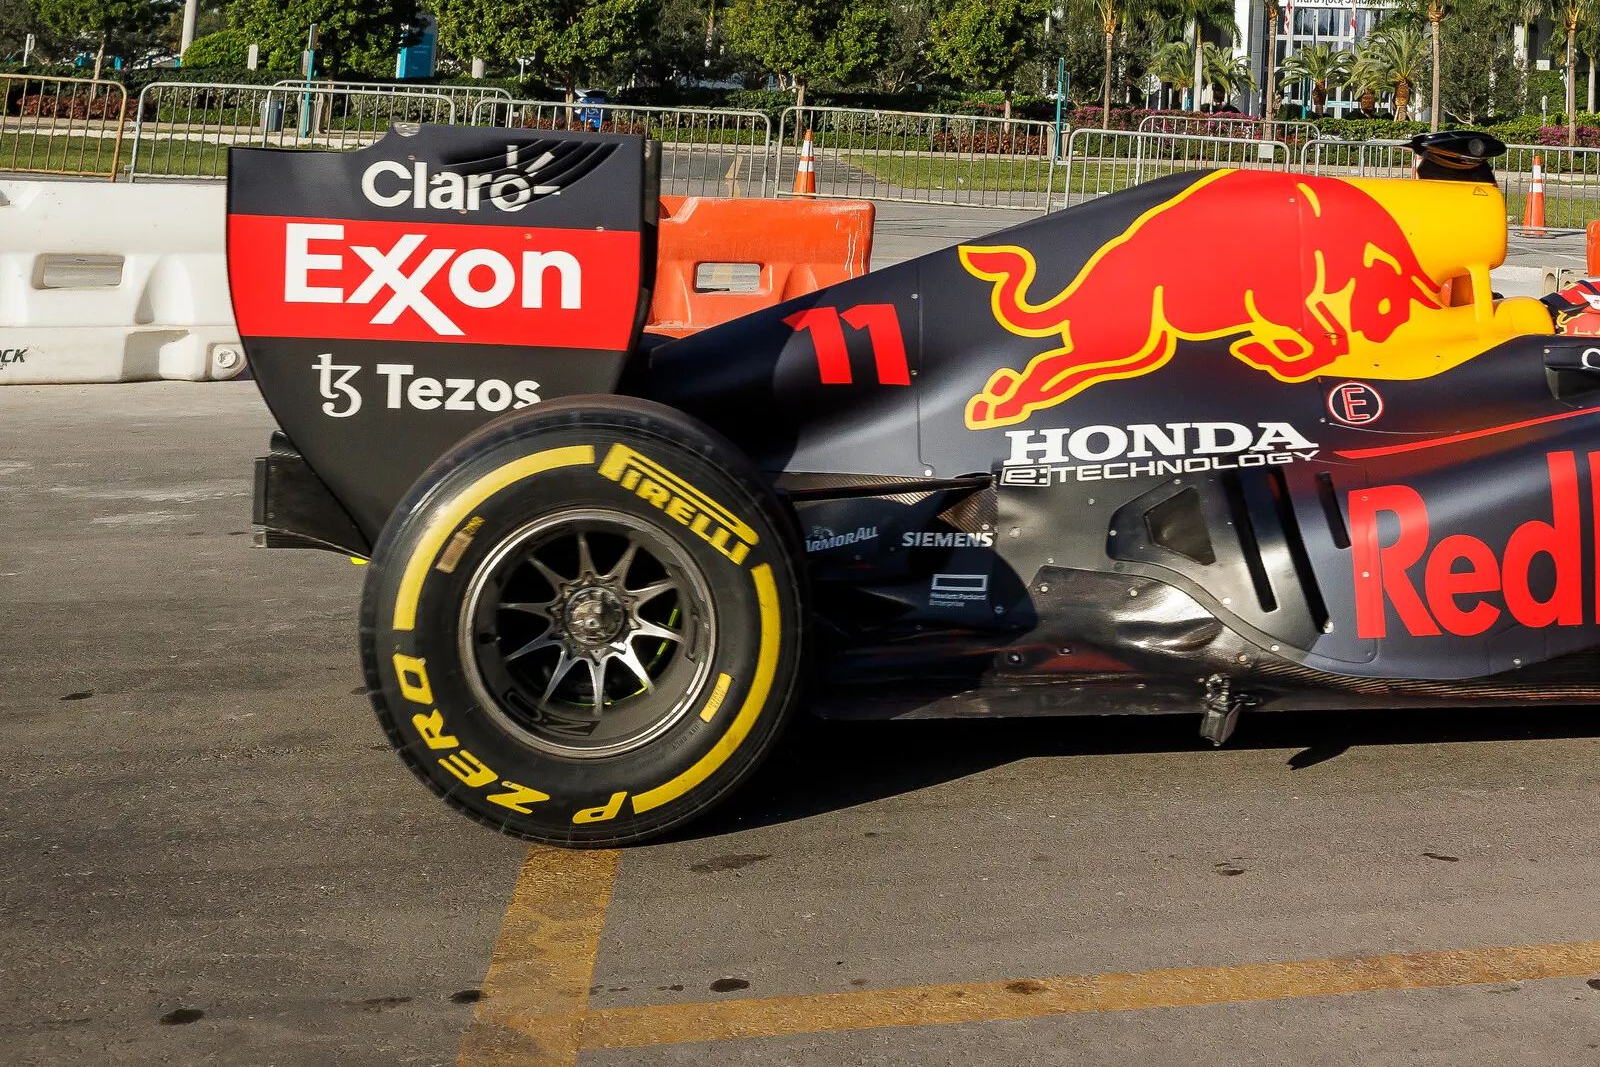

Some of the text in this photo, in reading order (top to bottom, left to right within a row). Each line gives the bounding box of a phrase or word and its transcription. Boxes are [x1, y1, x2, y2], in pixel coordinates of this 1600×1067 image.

[361, 153, 536, 212] Claro
[285, 223, 582, 335] Exxon
[0, 349, 28, 363] CK
[782, 303, 911, 386] 11
[376, 363, 542, 412] Tezos
[1341, 387, 1371, 420] E
[1003, 422, 1320, 466] HONDA
[597, 443, 760, 566] PIRELLI
[902, 532, 994, 548] SIEMENS
[392, 653, 628, 824] P ZERO
